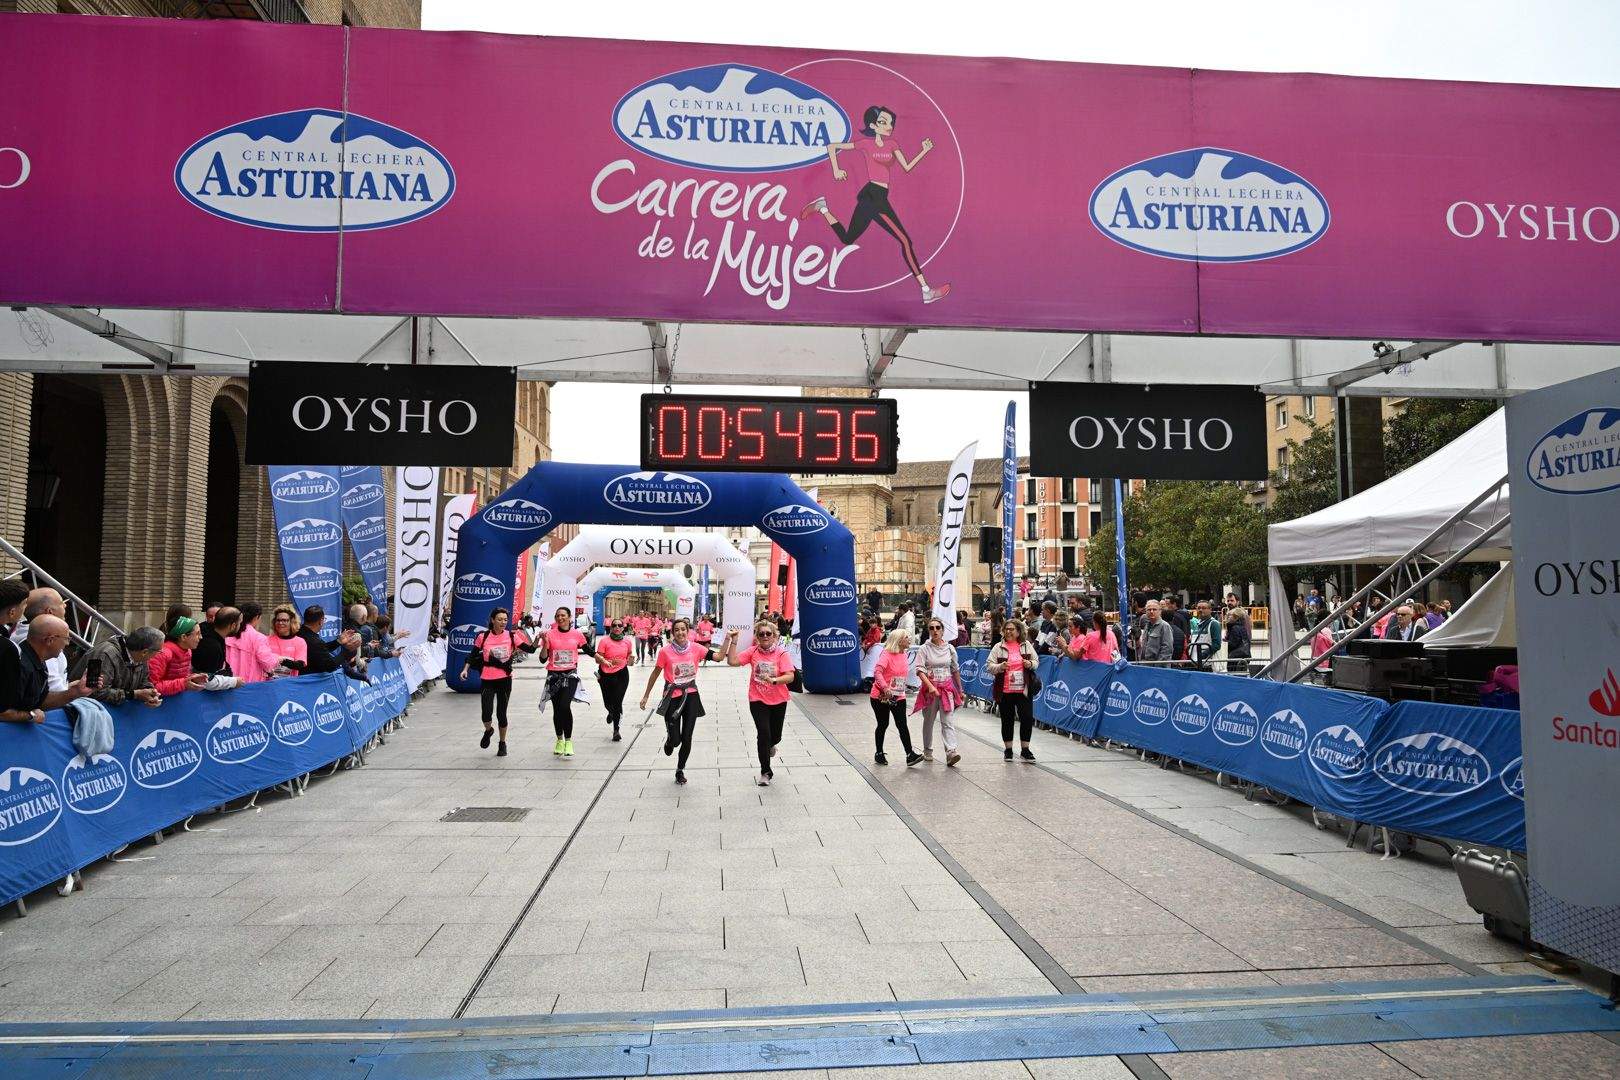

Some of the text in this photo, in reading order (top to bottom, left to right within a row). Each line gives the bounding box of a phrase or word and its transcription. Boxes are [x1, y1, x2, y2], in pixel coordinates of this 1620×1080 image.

[670, 98, 826, 115] CENTRAL LECHERA
[631, 99, 832, 147] ASTURIANA
[242, 149, 426, 167] CENTRAL LECHERA
[197, 151, 434, 203] ASTURIANA
[590, 159, 787, 221] Carrera
[1145, 185, 1304, 201] CENTRAL LECHERA
[1109, 187, 1313, 235] ASTURIANA
[1446, 201, 1620, 244] OYSHO
[638, 218, 861, 310] de la Mujer
[291, 395, 478, 436] OYSHO
[1069, 415, 1233, 452] OYSHO
[1555, 437, 1600, 453] CENTRAL
[612, 483, 703, 504] ASTURIANA
[487, 509, 546, 524] ASTURIANA
[768, 515, 824, 528] ASTURIANA
[400, 466, 434, 609] OYSHO
[610, 538, 693, 556] OYSHO
[938, 472, 969, 608] OYSHO
[715, 556, 741, 564] OYSHO
[456, 583, 501, 596] ASTURIANA
[808, 589, 853, 600] ASTURIANA
[810, 638, 855, 649] ASTURIANA
[1214, 714, 1255, 738] ASTURIANA
[1553, 716, 1620, 748] Santa
[212, 730, 267, 757] ASTURIANA
[137, 748, 199, 780] ASTURIANA
[1380, 751, 1480, 785] ASTURIANA
[68, 772, 124, 804] ASTURIANA
